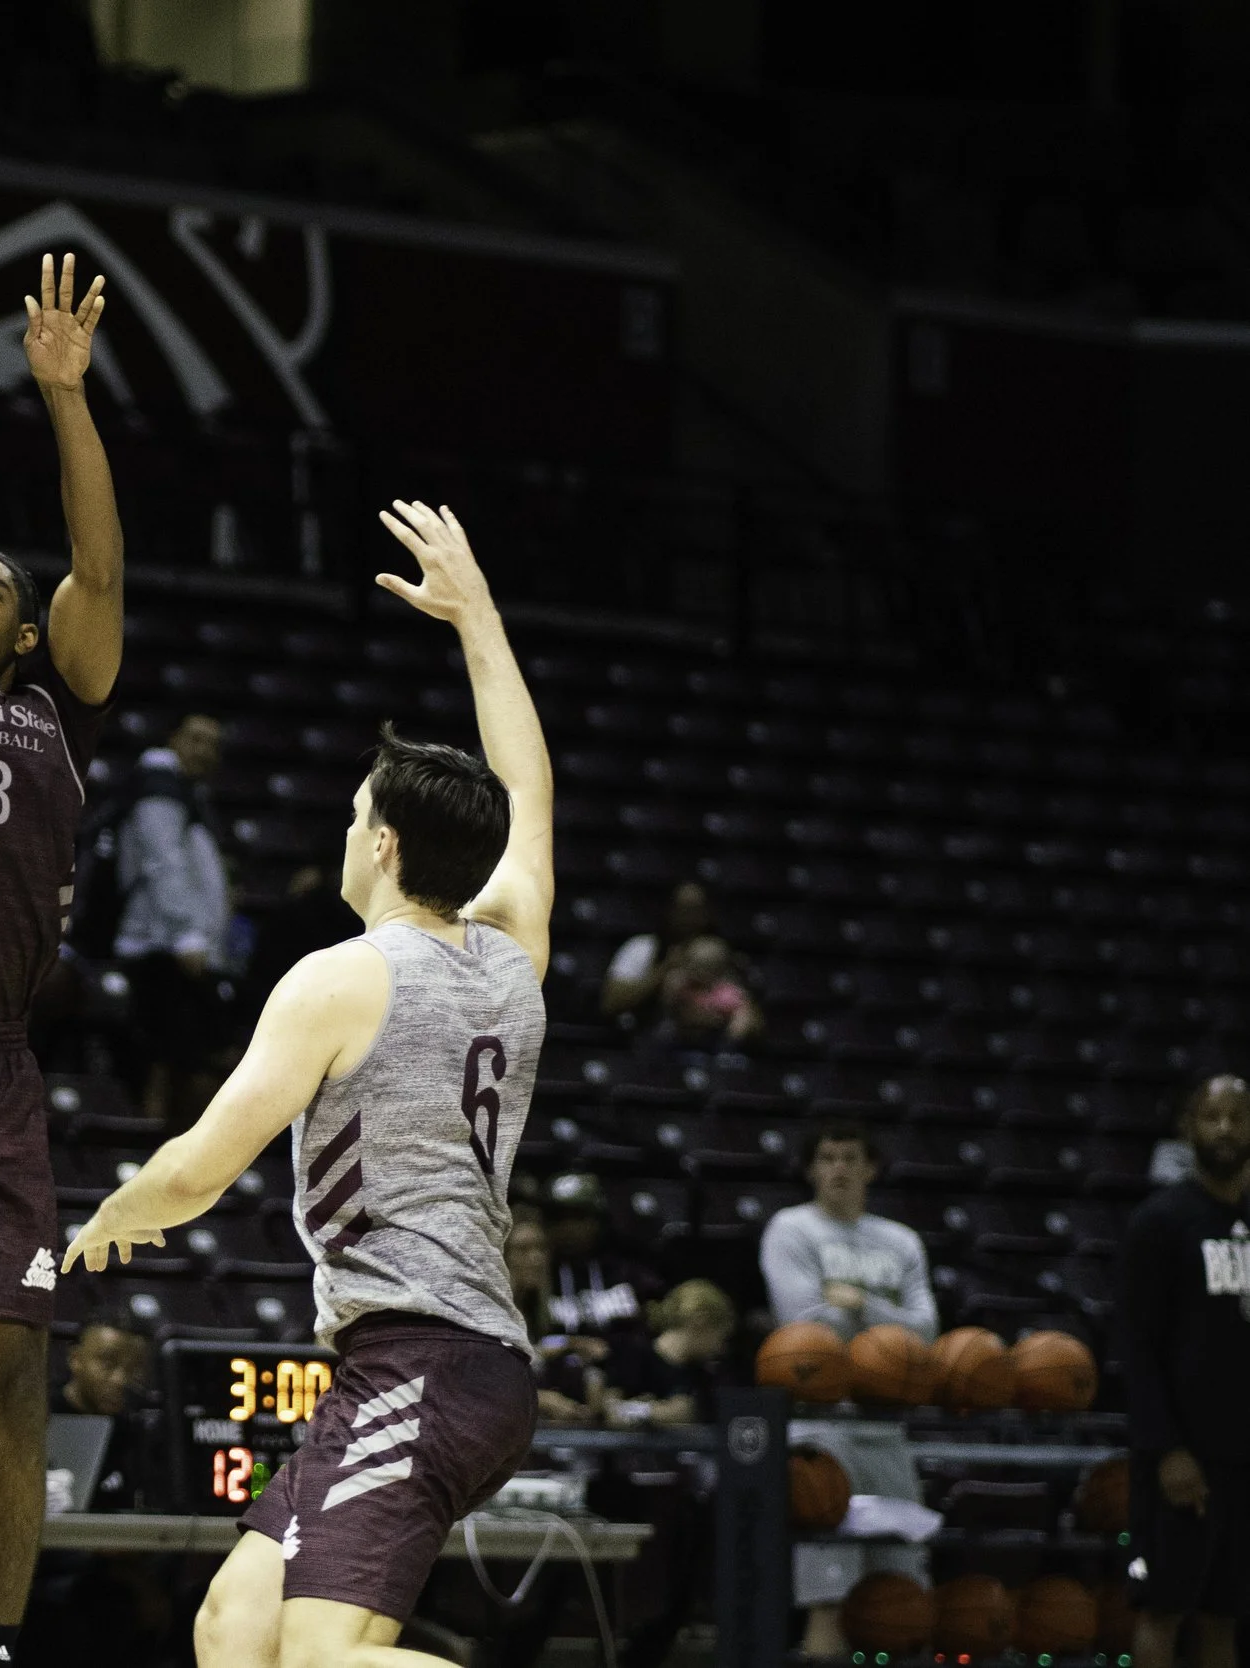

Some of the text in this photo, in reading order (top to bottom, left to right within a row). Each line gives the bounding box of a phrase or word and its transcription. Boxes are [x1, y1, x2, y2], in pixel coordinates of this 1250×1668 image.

[461, 1036, 507, 1175] 6
[229, 1357, 332, 1423] 3:00
[212, 1447, 254, 1503] 12
